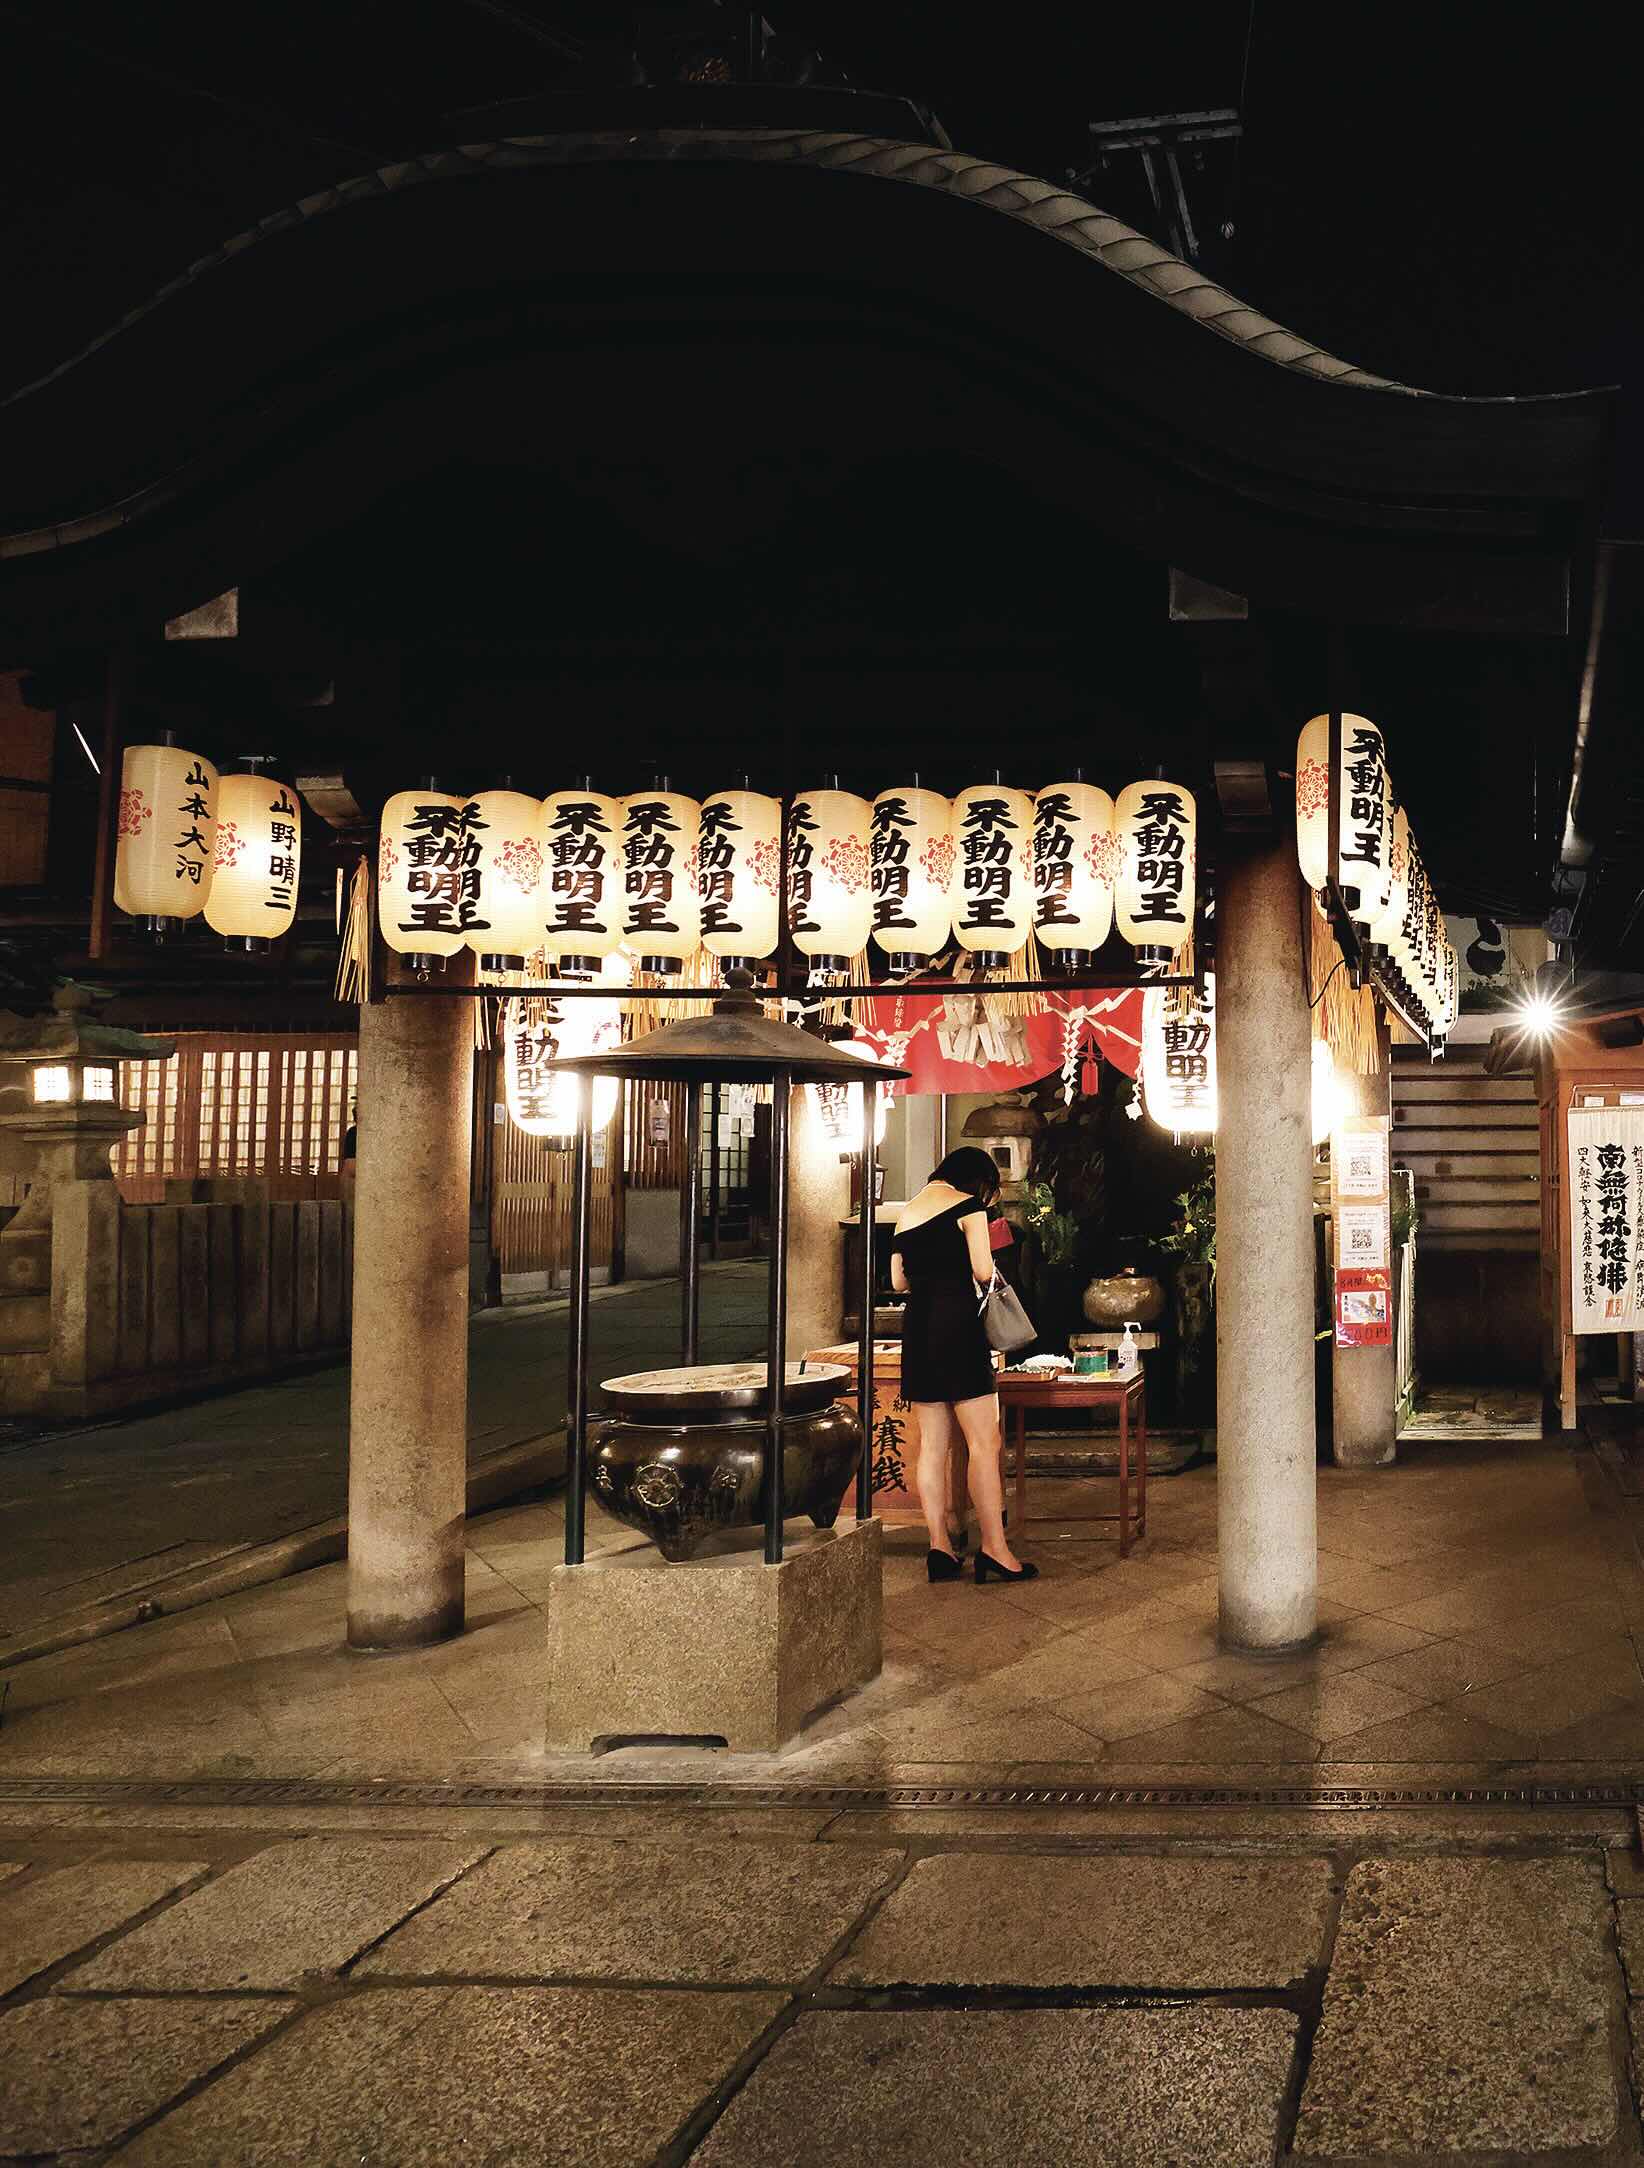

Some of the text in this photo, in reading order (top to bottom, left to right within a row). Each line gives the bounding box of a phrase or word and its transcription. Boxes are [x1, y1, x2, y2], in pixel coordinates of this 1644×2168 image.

[174, 762, 211, 885] 山本大河
[265, 789, 296, 910] 山野晴三
[1033, 793, 1082, 929] 不動明王
[1130, 793, 1191, 924] 不動明王
[1341, 728, 1384, 868] 不動明王
[546, 803, 613, 934] 不動明王
[622, 802, 682, 934] 不動明王
[698, 802, 744, 936] 不動明王
[868, 798, 918, 932] 不動明王
[959, 799, 1019, 930] 不動明王
